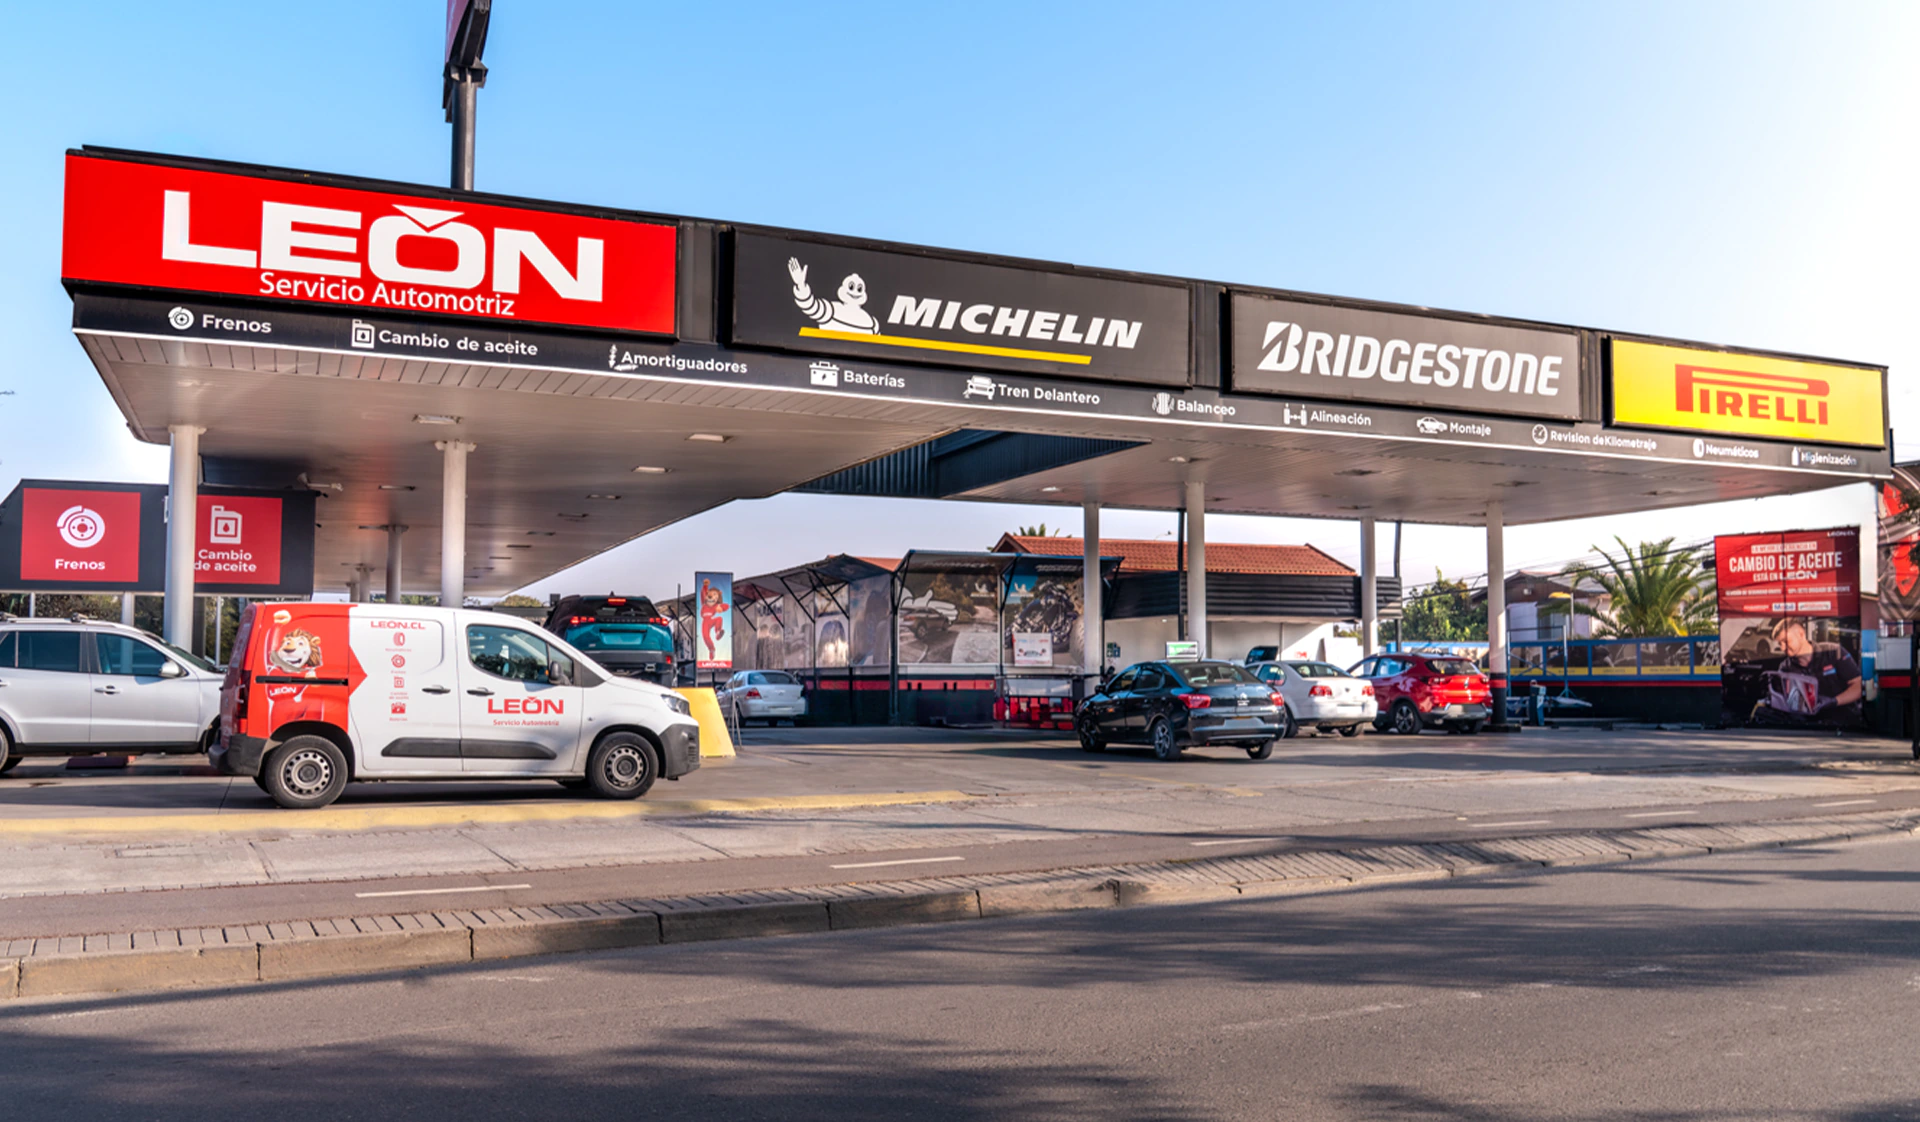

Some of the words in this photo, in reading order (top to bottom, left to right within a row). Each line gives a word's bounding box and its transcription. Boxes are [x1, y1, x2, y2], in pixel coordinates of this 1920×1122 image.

[259, 271, 364, 303] Servicio
[371, 282, 515, 316] Automotriz
[201, 313, 272, 334] Frenos
[887, 294, 1142, 349] MICHELIN
[378, 329, 449, 349] Cambio
[456, 336, 479, 353] de
[484, 339, 538, 356] aceite
[621, 350, 748, 374] Amortiguadores
[1256, 320, 1562, 396] BRIDGESTONE
[843, 369, 906, 389] Baterías
[998, 383, 1030, 400] Tren
[1033, 386, 1100, 405] Delantero
[1675, 363, 1829, 426] PIRELLI
[1177, 399, 1236, 417] Balanceo
[1310, 410, 1371, 427] Alineación
[1449, 421, 1492, 437] Montaje
[1550, 430, 1590, 445] Revision
[1705, 443, 1760, 460] Neumáticos
[55, 558, 106, 570] Frenos
[198, 549, 253, 561] Cambio
[1729, 555, 1776, 573] CAMBIO
[1778, 553, 1794, 570] DE
[1798, 552, 1843, 569] ACEITE
[194, 560, 210, 571] de
[214, 561, 257, 573] aceite
